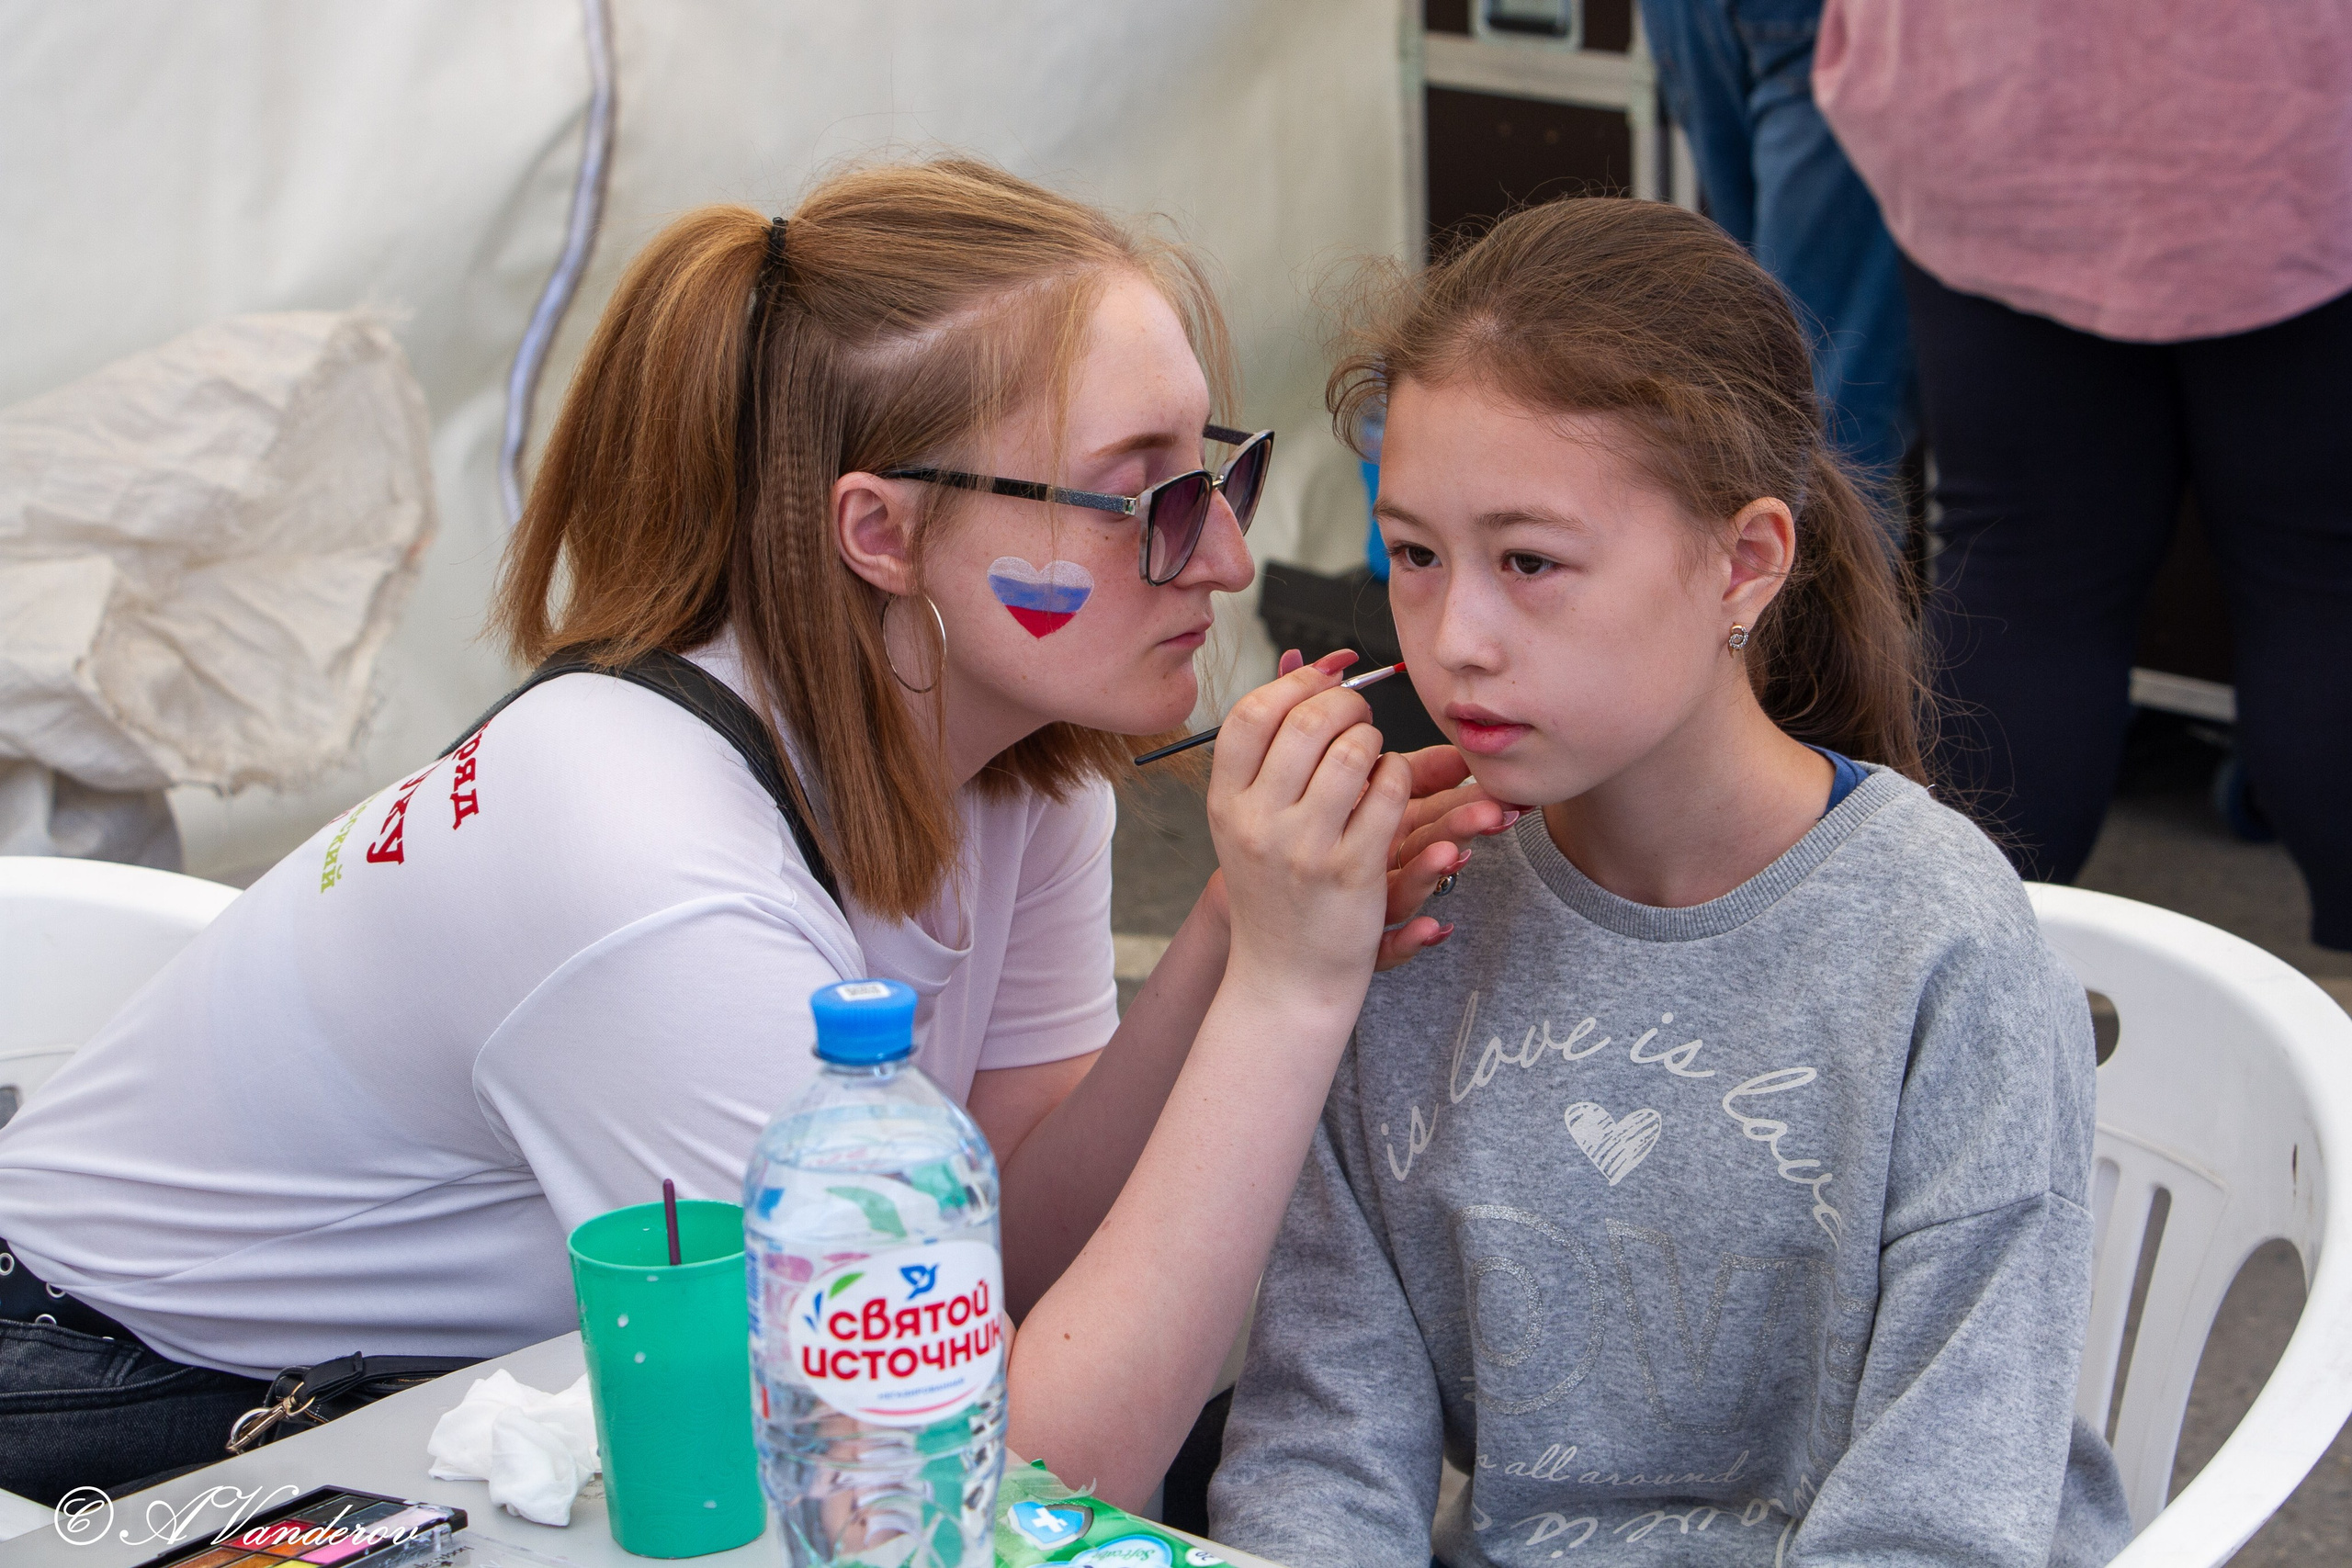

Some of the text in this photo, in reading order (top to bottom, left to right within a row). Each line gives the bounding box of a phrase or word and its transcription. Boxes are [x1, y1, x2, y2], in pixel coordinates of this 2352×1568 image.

[449, 715, 495, 830] ряд
[1380, 1101, 1440, 1182] is
[1449, 990, 1611, 1103] love
[1629, 1011, 1715, 1077] is
[1504, 1443, 1578, 1483] all
[1577, 1450, 1749, 1486] around
